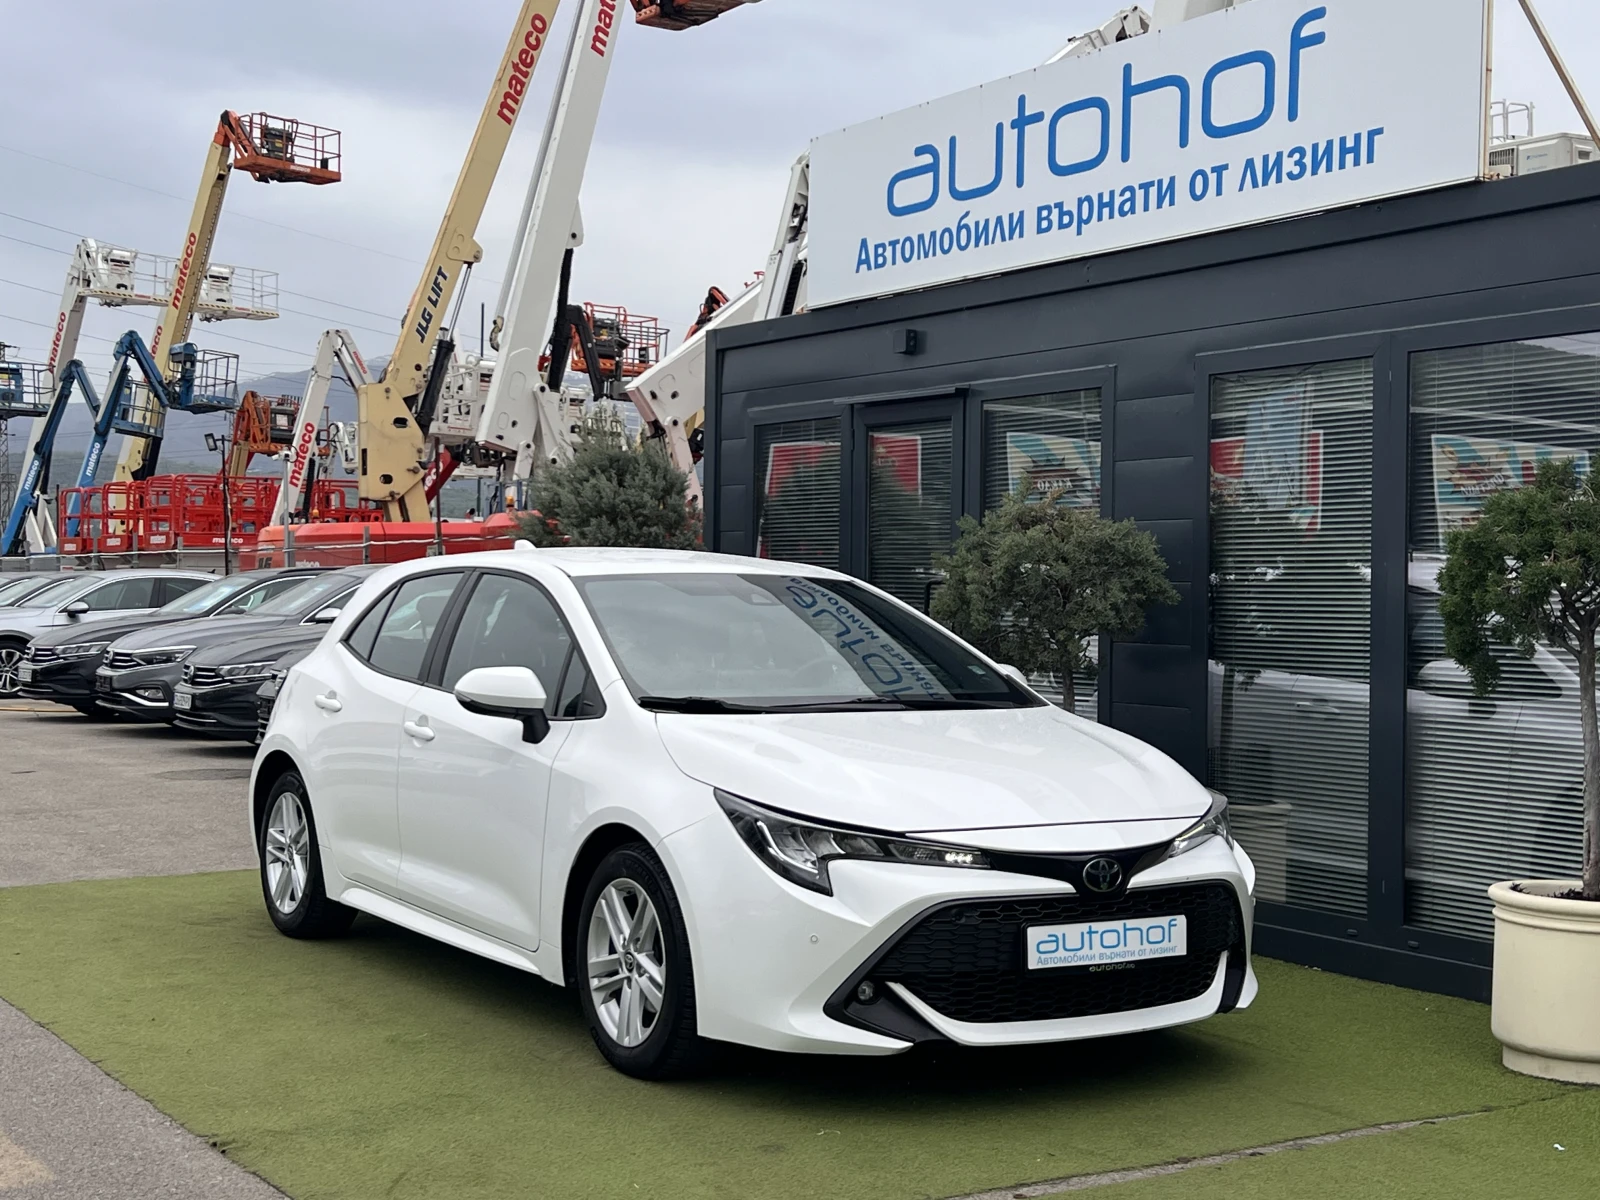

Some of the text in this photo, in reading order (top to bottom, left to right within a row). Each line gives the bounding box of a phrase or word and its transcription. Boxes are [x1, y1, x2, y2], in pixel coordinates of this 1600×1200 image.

[496, 12, 548, 126] mateco
[886, 6, 1326, 217] autohof
[855, 127, 1385, 274] Автомобили върнати от лизинг
[171, 231, 198, 311] mateco
[415, 265, 448, 344] JLG LIFT
[48, 311, 67, 375] mateco
[24, 459, 39, 491] mateco
[84, 441, 101, 477] mateco
[288, 421, 316, 488] mateco
[1036, 918, 1178, 954] autohof
[1036, 945, 1178, 966] Автомобили върнати от лизинг
